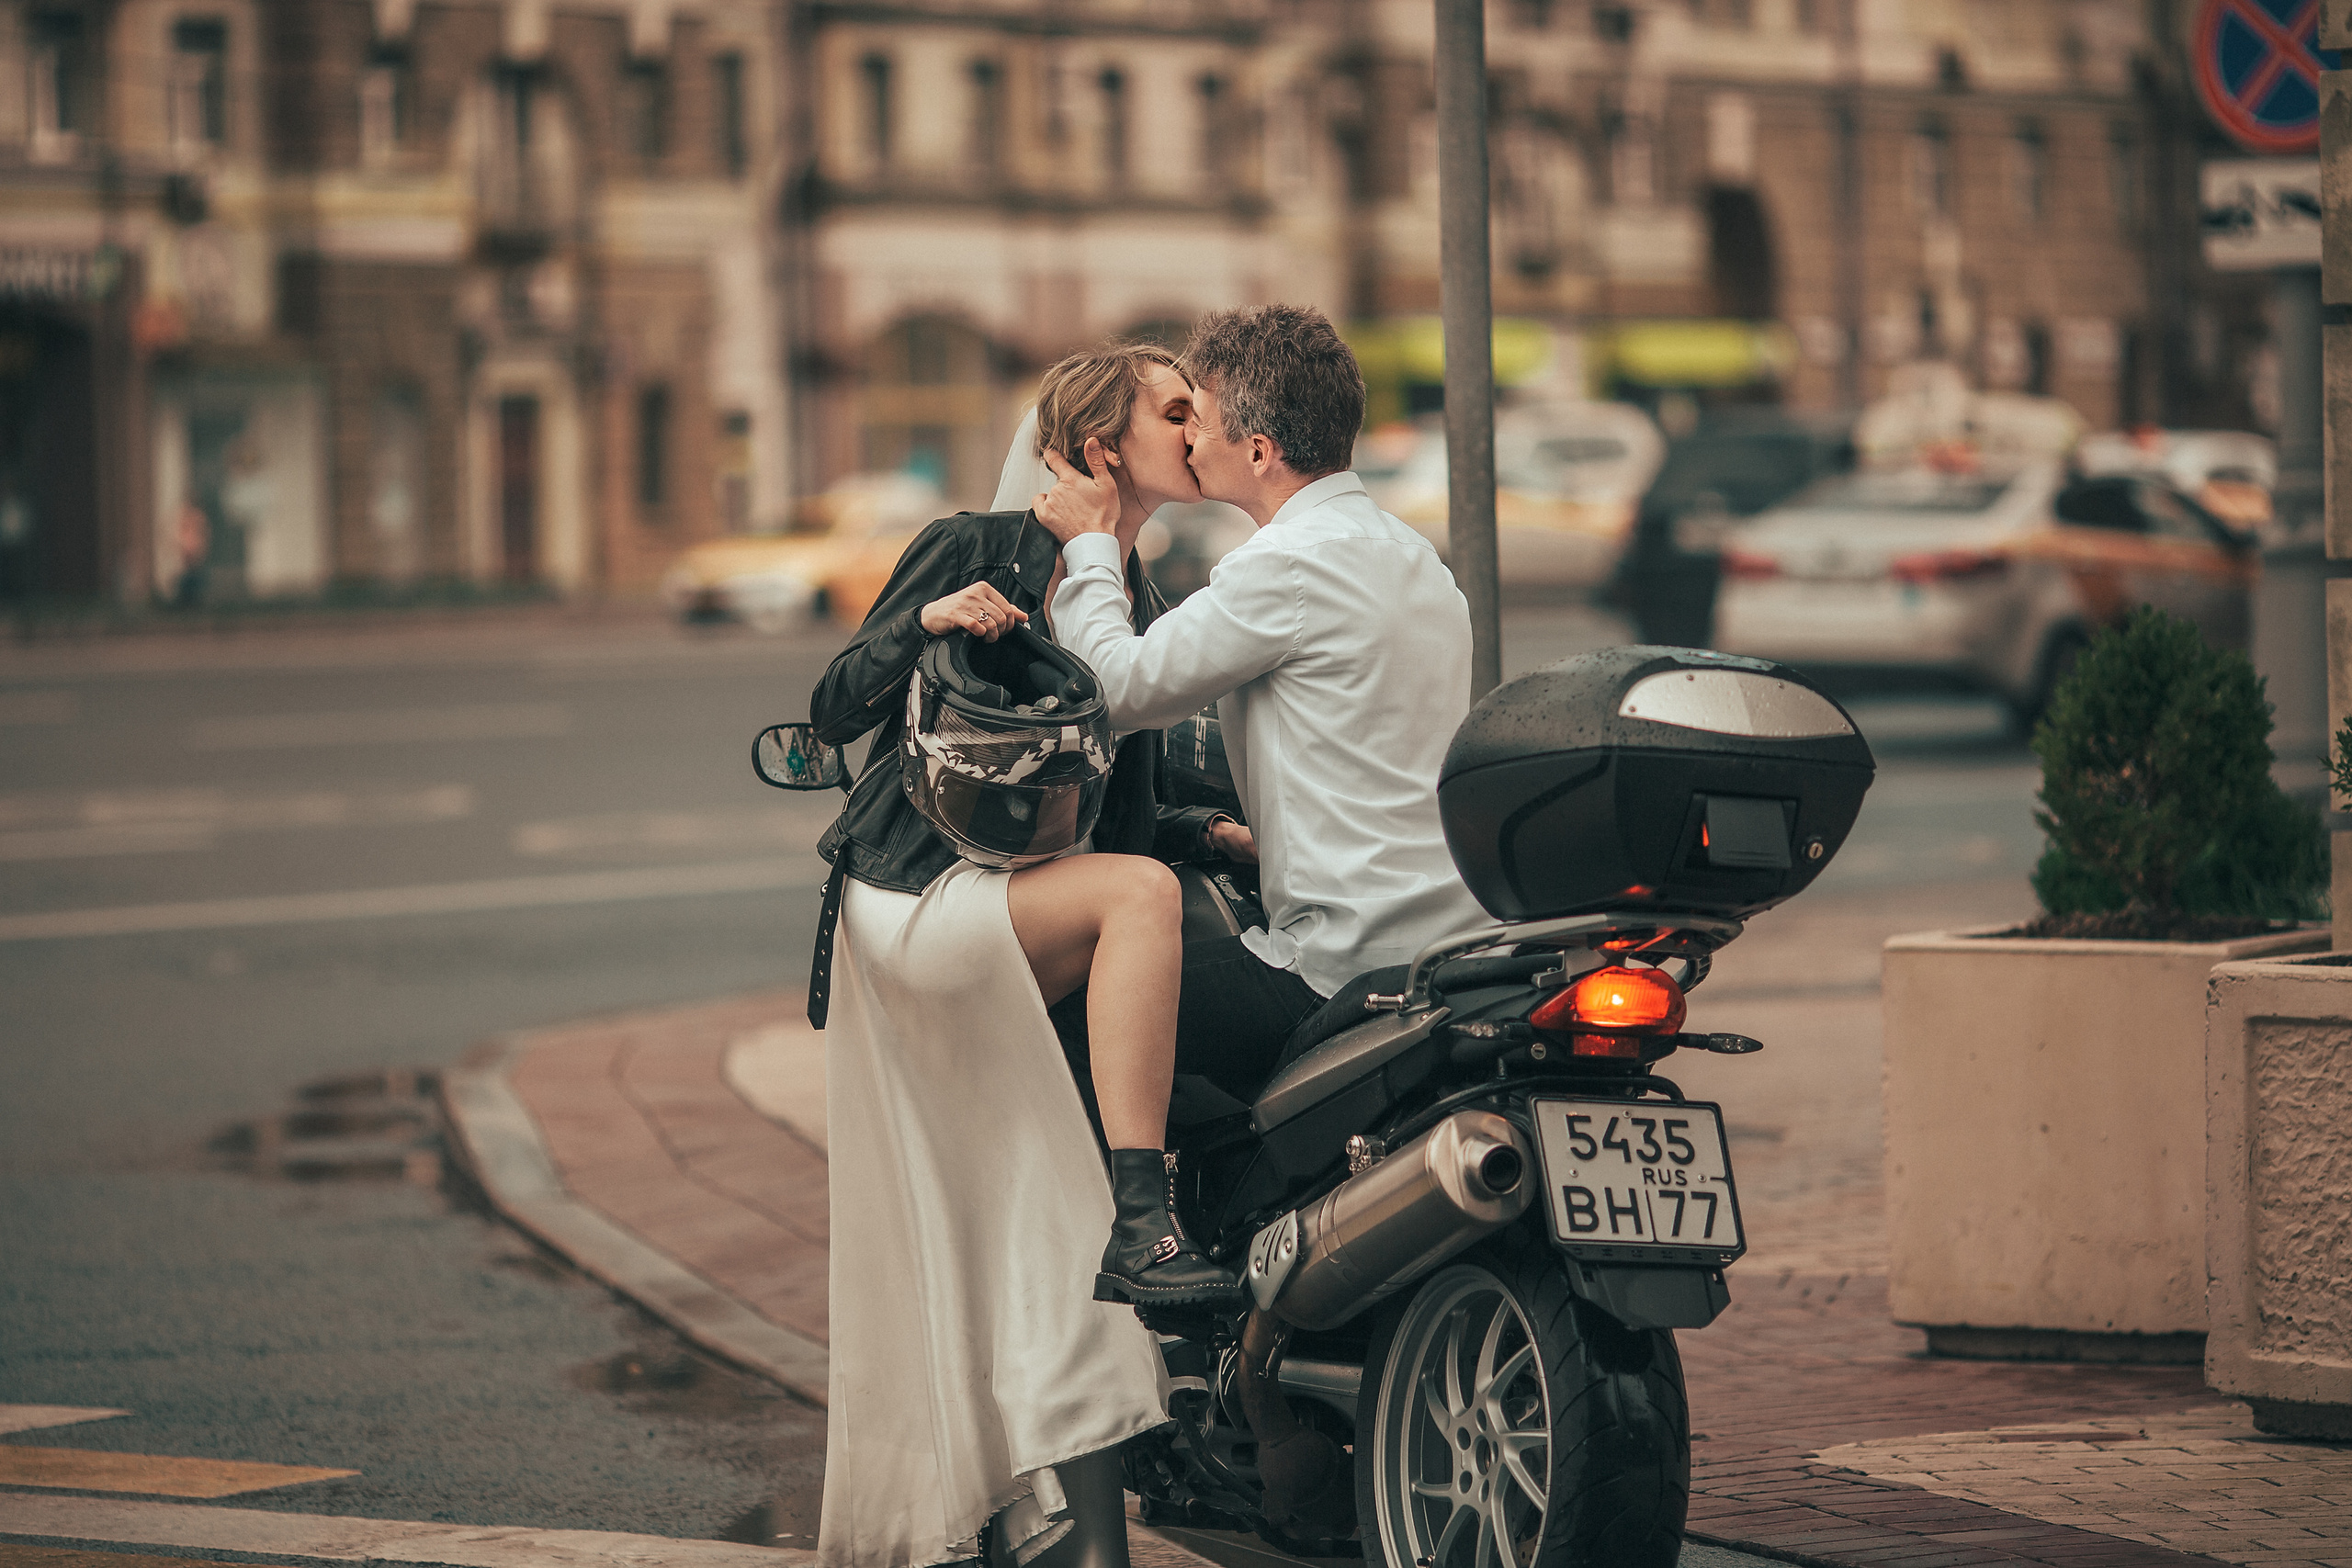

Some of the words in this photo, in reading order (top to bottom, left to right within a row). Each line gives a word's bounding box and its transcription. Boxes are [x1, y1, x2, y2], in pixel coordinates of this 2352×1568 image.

[1565, 1114, 1695, 1166] 5435
[1642, 1168, 1688, 1187] RUS
[1562, 1185, 1644, 1235] BH
[1658, 1190, 1718, 1239] 77
